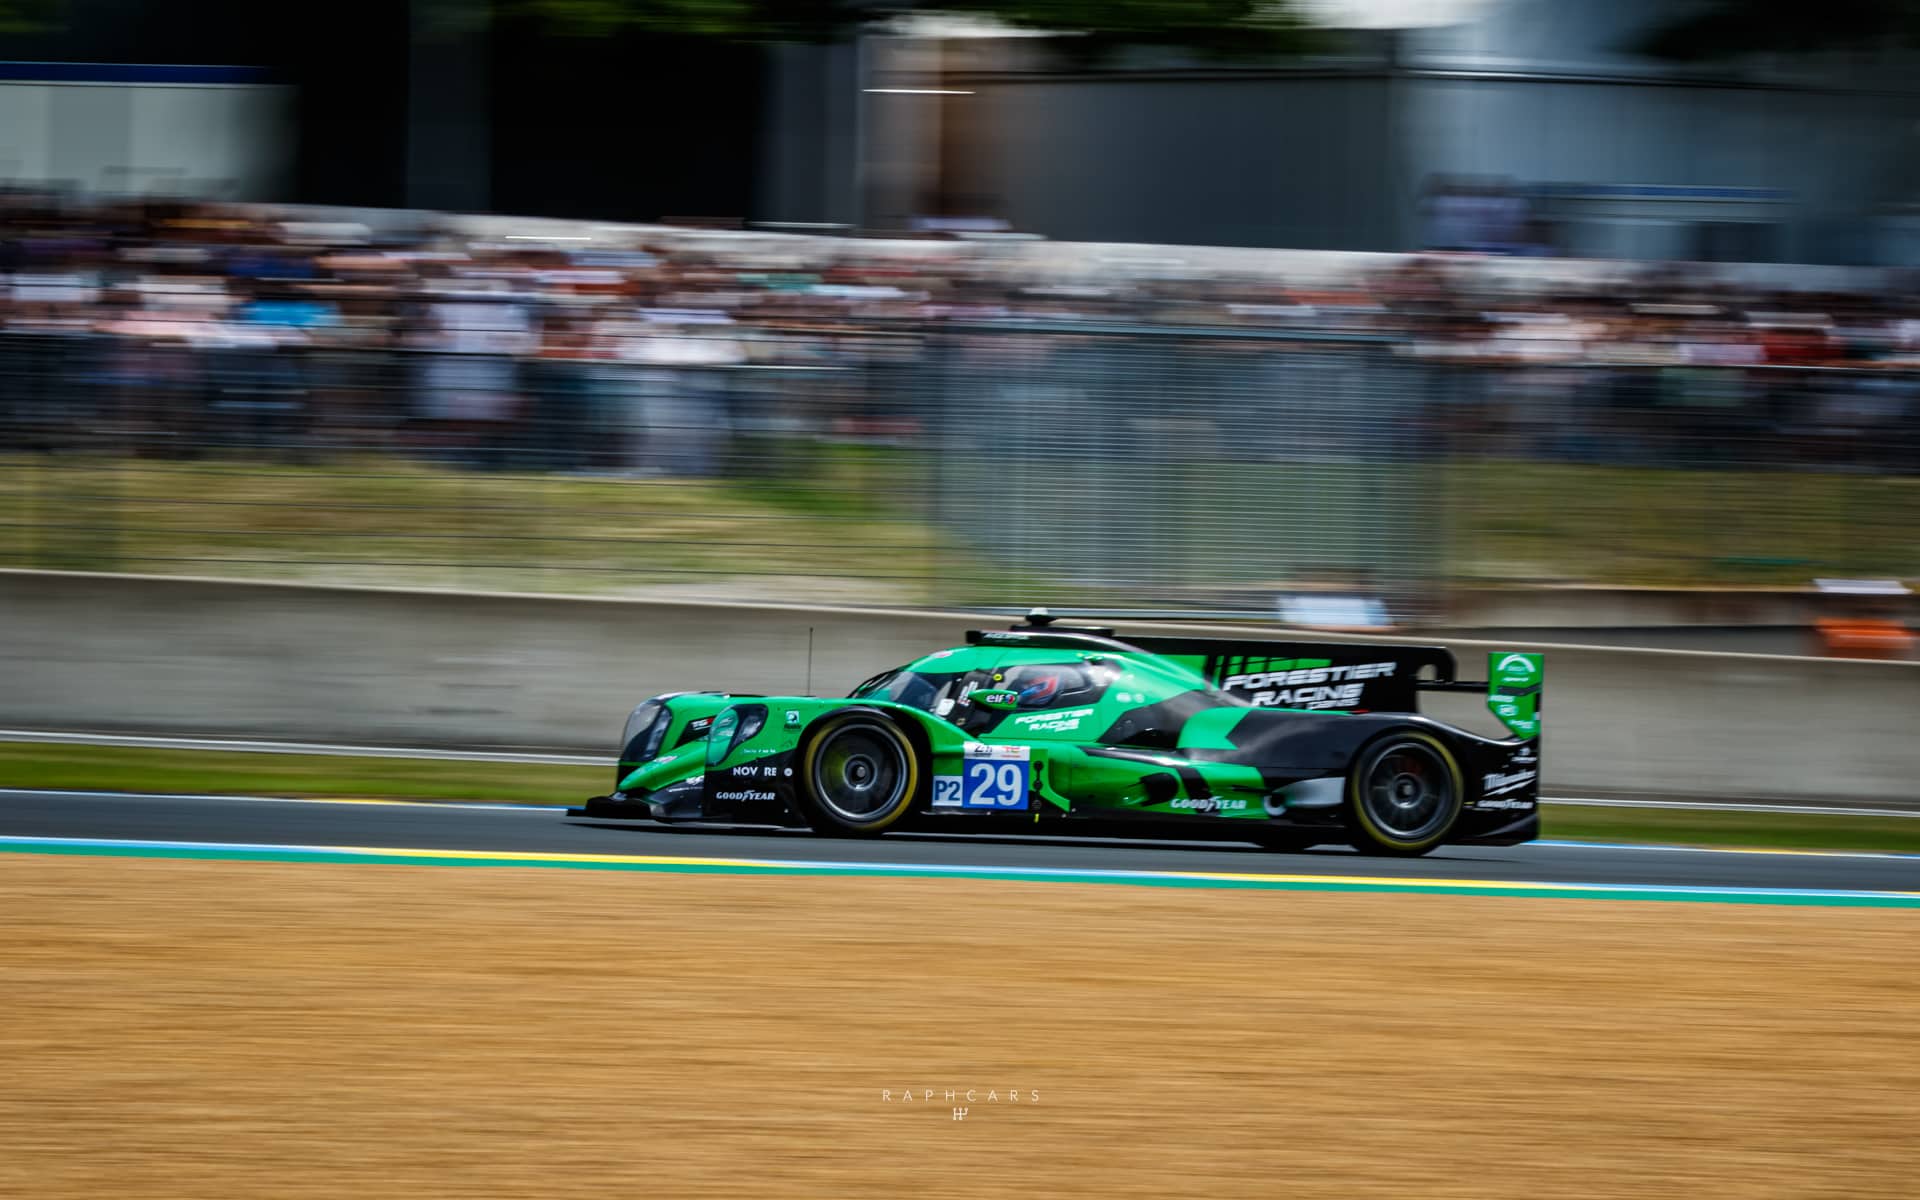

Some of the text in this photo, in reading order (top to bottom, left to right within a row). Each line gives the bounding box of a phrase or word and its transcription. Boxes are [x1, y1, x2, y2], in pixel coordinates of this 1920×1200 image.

[1222, 662, 1397, 691] FORESTIER
[986, 693, 1004, 703] elf
[1250, 683, 1365, 708] RACING
[1015, 708, 1094, 725] FORESTIER
[934, 780, 961, 801] P2
[969, 763, 1022, 806] 29
[716, 790, 776, 802] GOODYEAR
[1170, 796, 1247, 812] GOODYEAR
